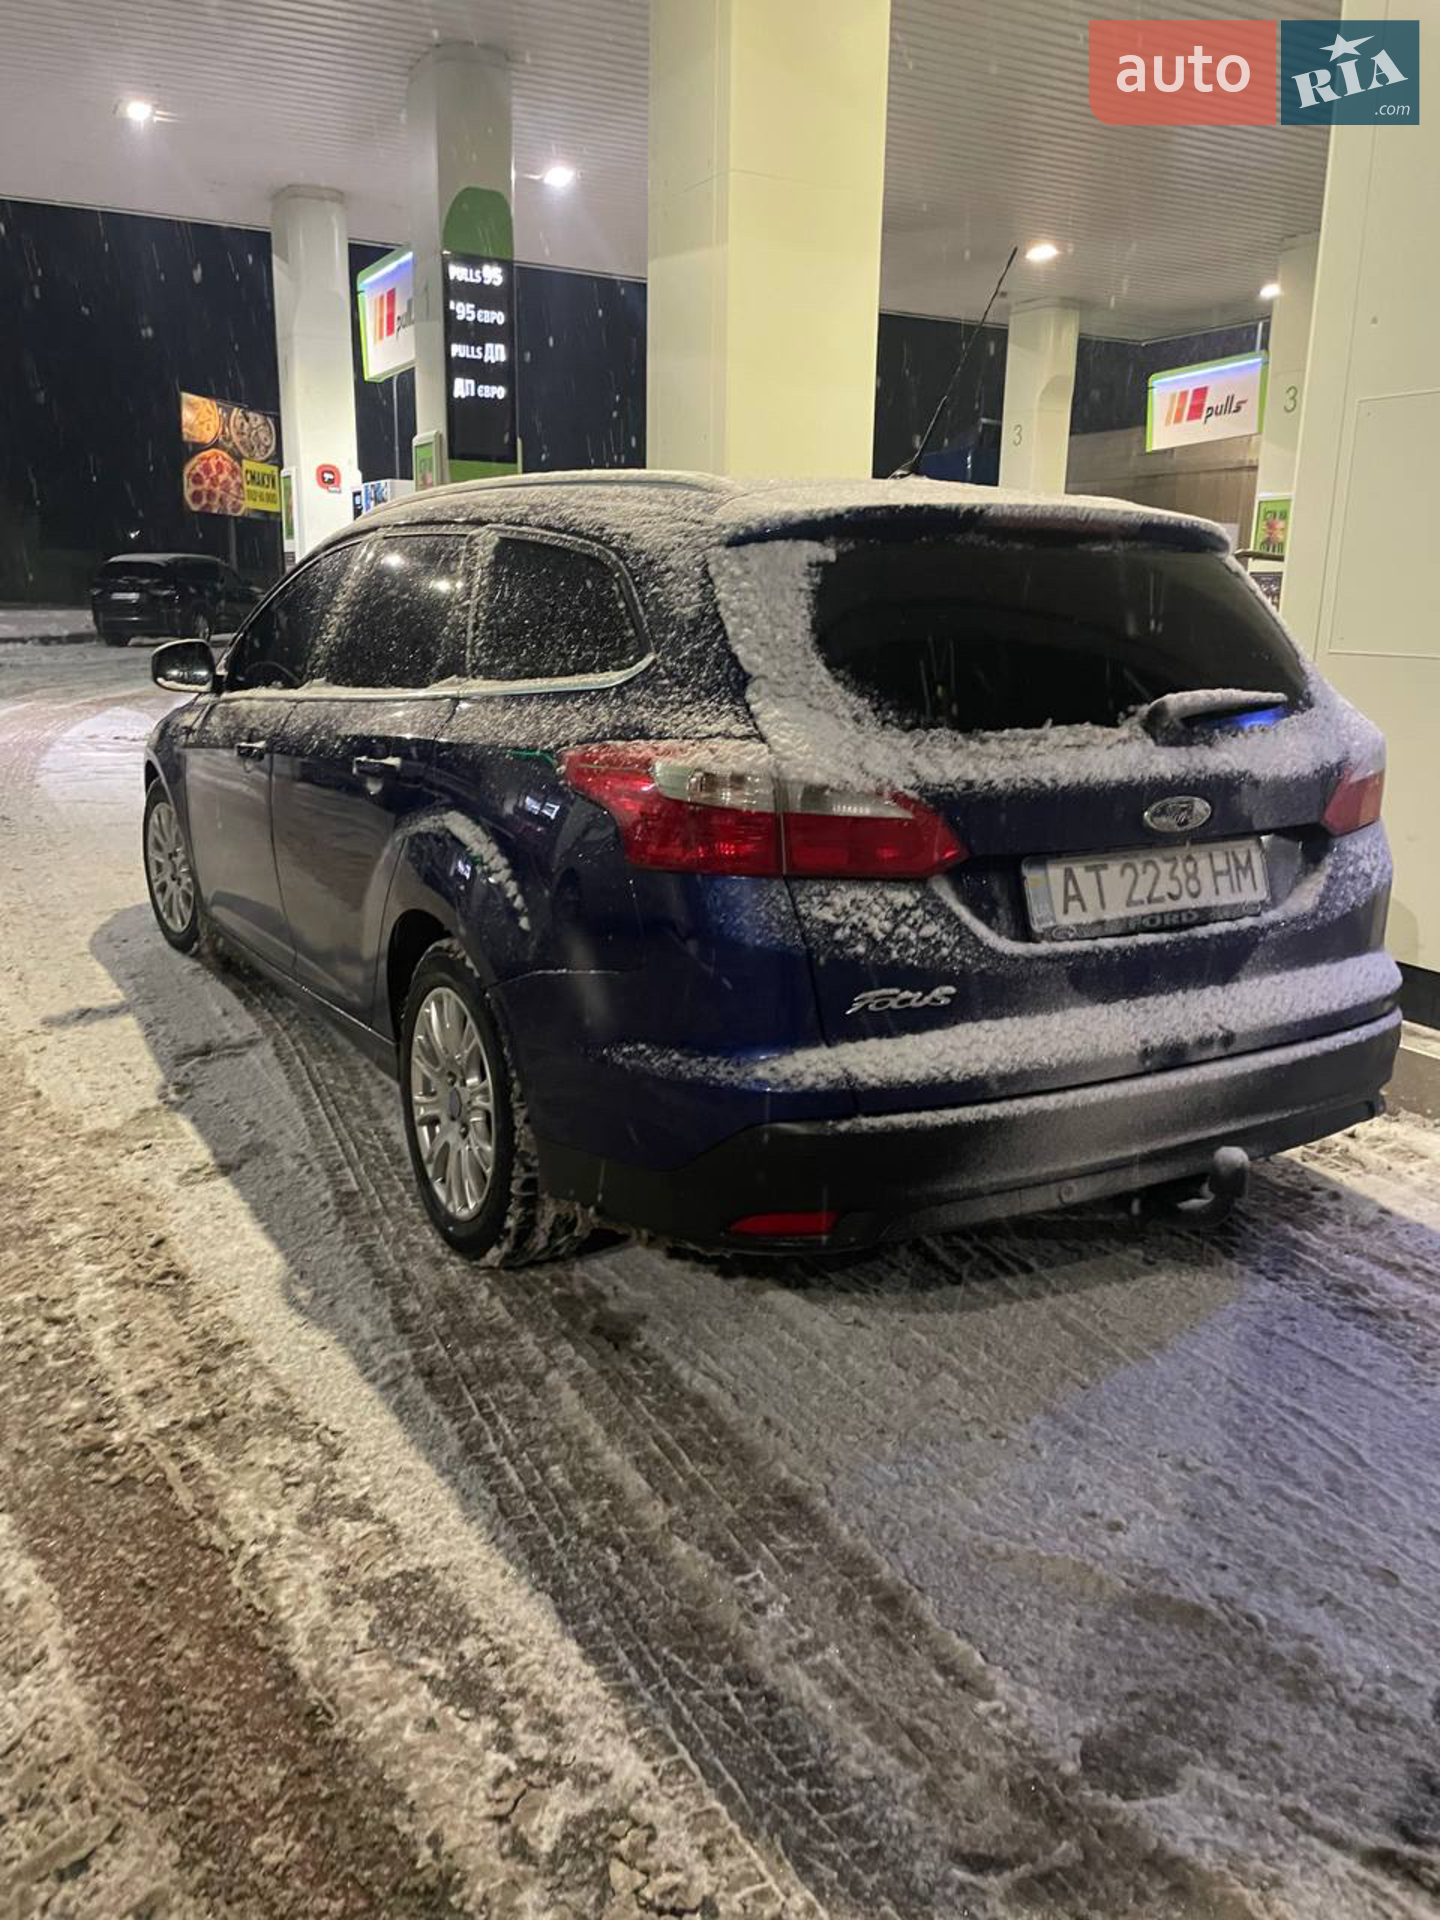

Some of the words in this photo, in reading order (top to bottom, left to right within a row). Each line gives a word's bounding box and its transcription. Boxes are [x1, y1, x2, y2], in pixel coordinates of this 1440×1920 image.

[448, 263, 482, 284] PULLS
[482, 263, 503, 286] 95
[451, 342, 483, 360] PULLS
[1203, 394, 1248, 425] pulls
[1283, 385, 1298, 413] 3
[1013, 423, 1022, 447] 3
[1061, 862, 1109, 916] AT
[1119, 853, 1203, 909] 2238
[1208, 848, 1259, 897] HM
[1127, 911, 1199, 930] FORD
